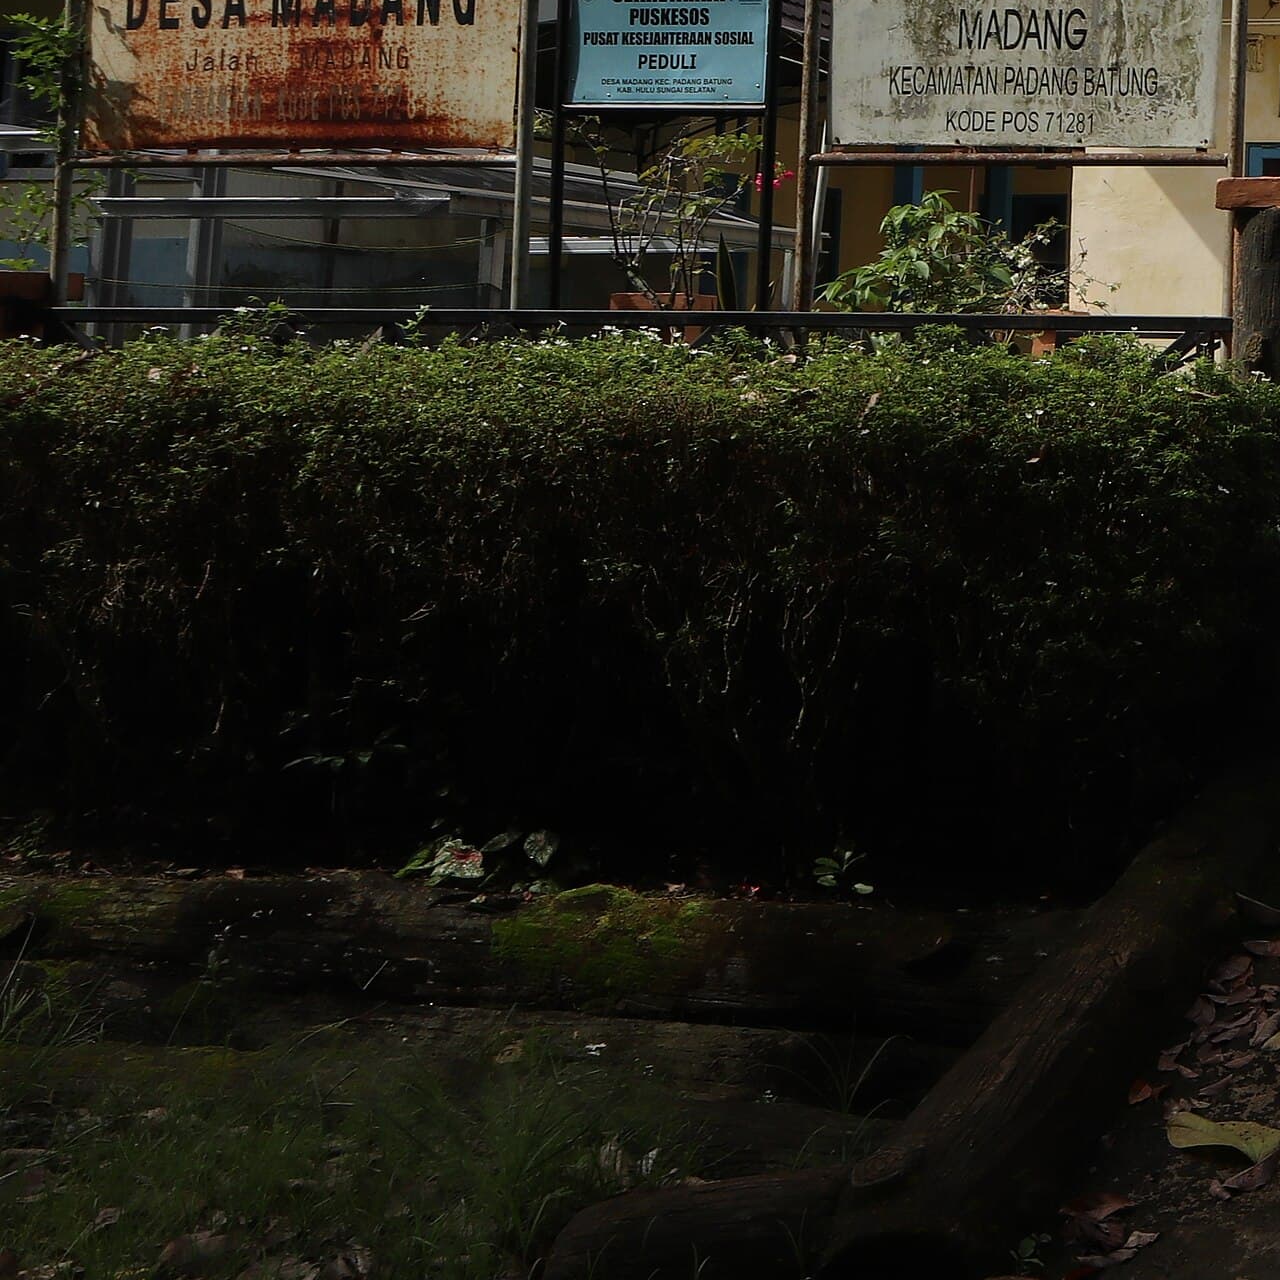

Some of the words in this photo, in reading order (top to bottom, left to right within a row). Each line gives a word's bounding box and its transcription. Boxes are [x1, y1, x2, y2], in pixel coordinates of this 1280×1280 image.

[629, 8, 710, 26] PUSKESOS
[583, 32, 619, 46] PUSAT
[621, 31, 712, 46] KESEJAHTERAAN
[714, 31, 754, 46] SOSIAL
[957, 7, 1088, 52] MADANG
[185, 49, 258, 72] Jalan
[300, 46, 410, 71] MADANG
[638, 54, 697, 70] PEDULI
[635, 86, 655, 94] HULU
[656, 86, 683, 94] SUNGAI
[684, 86, 716, 94] SELATAN
[888, 65, 998, 97] KECAMATAN
[1003, 65, 1078, 97] PADANG
[1084, 65, 1159, 97] BATUNG
[945, 111, 994, 133] KODE
[1001, 111, 1039, 133] POS
[1046, 112, 1095, 135] 71281
